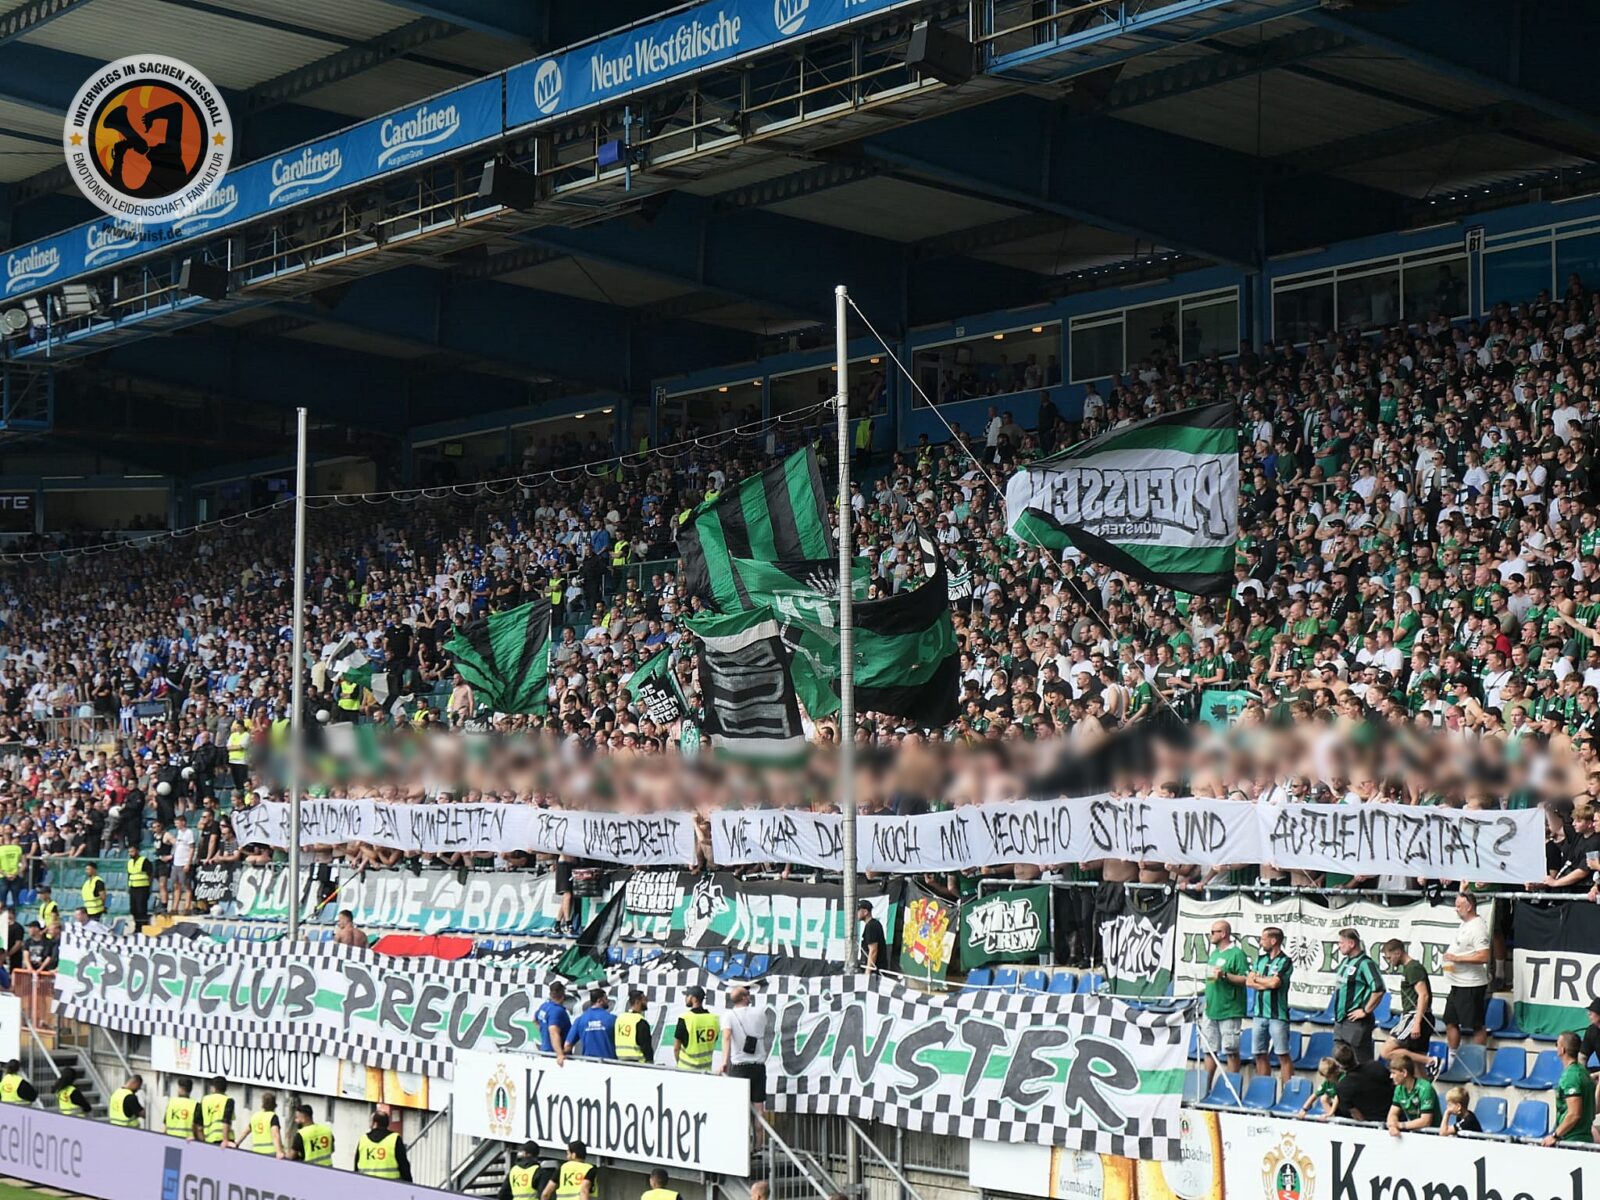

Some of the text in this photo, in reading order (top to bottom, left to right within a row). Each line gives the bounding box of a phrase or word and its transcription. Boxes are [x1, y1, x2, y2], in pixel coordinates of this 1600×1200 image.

[591, 10, 741, 93] Neue Westfälische
[379, 103, 459, 149] Carolinen
[271, 147, 341, 186] Carolinen
[7, 246, 60, 279] Carolinen
[582, 817, 681, 857] UMGEDREHT
[759, 814, 802, 856] WAR
[814, 819, 846, 860] DA
[871, 819, 922, 865] NOCH
[1171, 810, 1227, 855] UND
[986, 928, 1040, 953] CREW
[73, 948, 318, 1019] SPORTCLUB
[762, 983, 1141, 1131] ÜNSTER
[617, 1023, 631, 1037] K9
[695, 1028, 715, 1044] K9
[171, 1108, 189, 1120] K9
[524, 1067, 708, 1164] Krombacher
[310, 1135, 329, 1151] K9
[366, 1147, 386, 1161] K9
[512, 1173, 530, 1187] K9
[563, 1171, 584, 1186] K9
